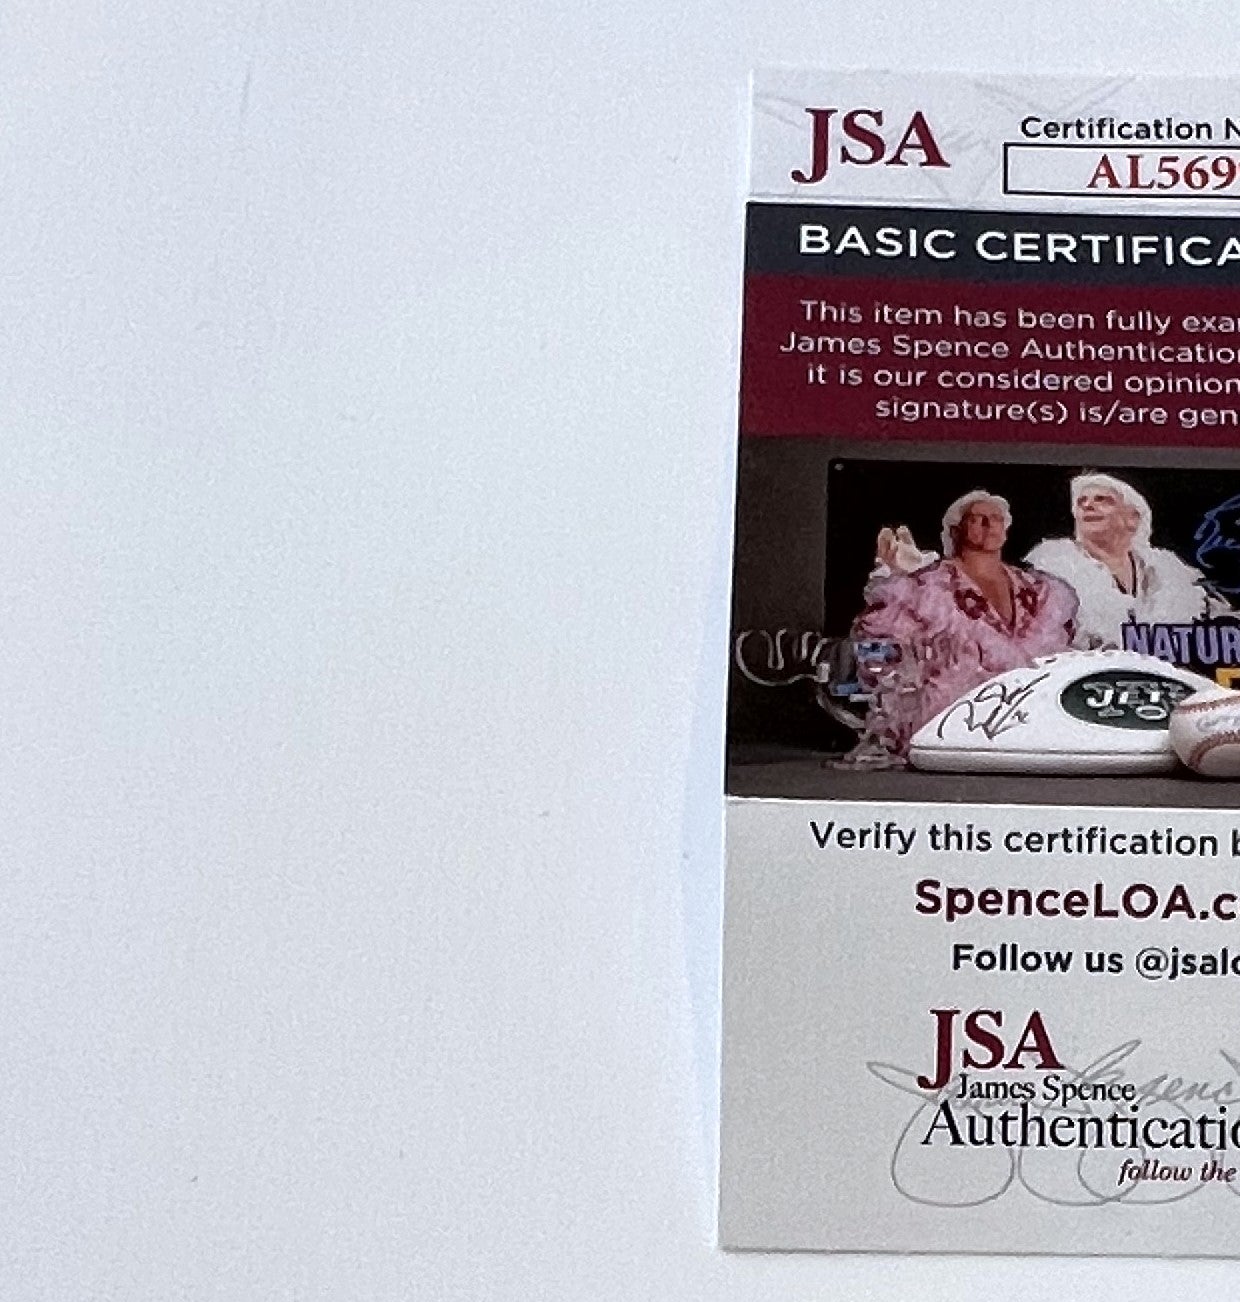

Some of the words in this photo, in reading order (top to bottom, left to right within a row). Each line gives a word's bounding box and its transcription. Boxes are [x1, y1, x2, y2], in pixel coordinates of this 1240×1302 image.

[791, 107, 951, 184] JSA
[1016, 115, 1213, 144] Certification
[799, 224, 957, 259] BASIC
[800, 299, 863, 323] This
[874, 304, 943, 325] item
[954, 305, 1007, 328] has
[1017, 308, 1095, 330] been
[1105, 309, 1171, 335] fully
[779, 331, 881, 355] James
[893, 334, 1009, 359] Spence
[808, 363, 827, 386] it
[839, 368, 863, 386] is
[873, 369, 927, 387] our
[937, 369, 1113, 392] considered
[876, 399, 1068, 425] signature(s)
[1079, 399, 1168, 425] is/are
[809, 821, 917, 855] Verify
[927, 823, 993, 853] this
[1003, 825, 1218, 857] certification
[952, 942, 1073, 973] Follow
[1085, 951, 1124, 974] us
[916, 1008, 1067, 1090] JSA
[955, 1073, 1036, 1101] James
[1042, 1073, 1137, 1106] Spence
[1117, 1158, 1193, 1187] follow
[1199, 1159, 1237, 1183] the
